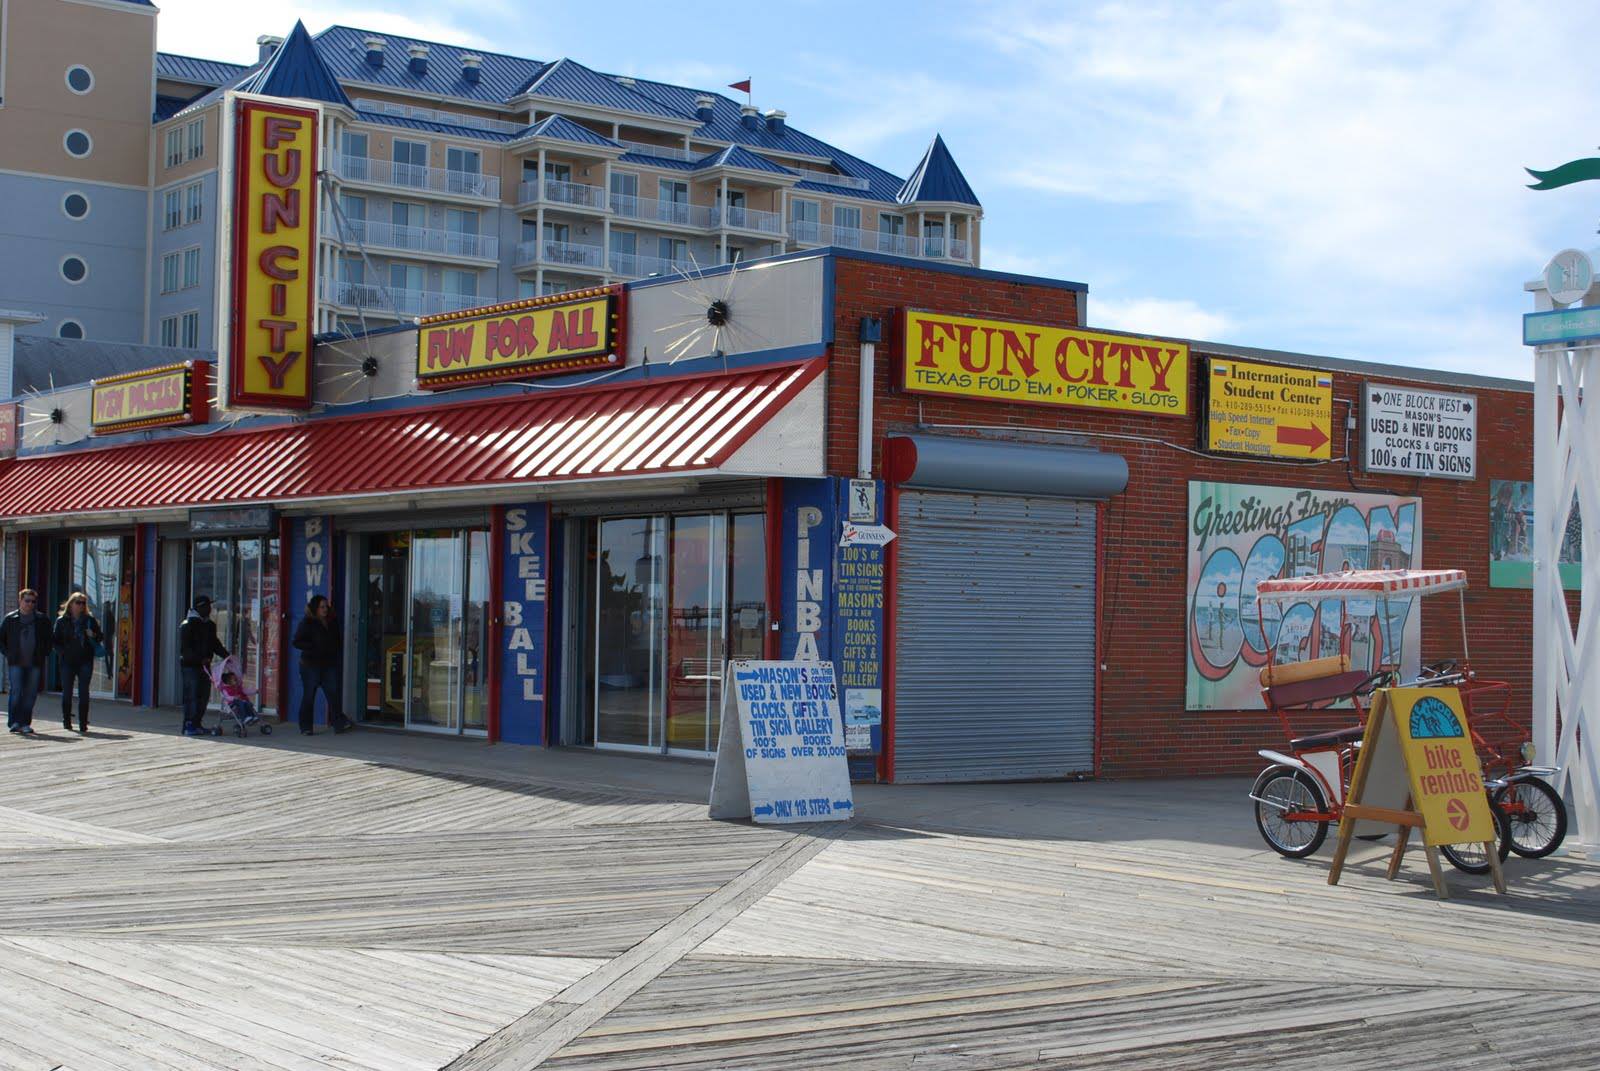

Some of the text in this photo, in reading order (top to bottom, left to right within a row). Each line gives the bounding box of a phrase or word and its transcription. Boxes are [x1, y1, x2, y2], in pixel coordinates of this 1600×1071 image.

[258, 116, 302, 390] FUN CITY
[427, 306, 598, 369] FUN FOR ALL
[915, 319, 1180, 392] FUN CITY
[1231, 364, 1317, 388] International
[914, 369, 1179, 408] TEXAS FOLD 'EM POKER SLOTS
[1223, 381, 1322, 405] Student Center
[1383, 392, 1461, 413] ONE BLOCK WEST
[1210, 410, 1275, 425] High Speed Internet
[1404, 410, 1441, 423] MASON'S
[1371, 418, 1472, 442] USED & NEW BOOKS
[1216, 438, 1271, 454] Student Housing
[1385, 437, 1458, 454] CLOCKS & GIFTS
[1400, 451, 1412, 468] of
[1415, 452, 1434, 470] TIN
[1438, 454, 1471, 474] SIGNS
[1193, 496, 1294, 552] Greetings
[304, 516, 324, 603] BOW
[843, 547, 879, 561] 100'S OF
[841, 563, 884, 577] TIN SIGNS
[503, 508, 546, 701] SKEE BALL
[838, 592, 884, 609] MASON'S
[847, 619, 875, 632] BOOKS
[845, 632, 877, 646] CLOCKS
[843, 646, 877, 659] GIFTS &
[842, 660, 878, 673] TIN SIGN
[759, 668, 808, 684] MASON'S
[841, 673, 878, 687] GALLERY
[740, 684, 766, 701] USED
[769, 684, 777, 701] &
[781, 684, 802, 701] NEW
[805, 684, 837, 700] BOOKS
[792, 701, 819, 718] GIFTS
[822, 701, 829, 717] &
[749, 719, 767, 737] TIN
[769, 719, 792, 736] SIGN
[794, 718, 834, 735] GALLERY
[753, 735, 832, 748] 100'S BOOKS
[746, 746, 846, 759] OF SIGNS OVER 20,000
[1423, 745, 1463, 770] bike
[1419, 769, 1480, 795] rentals
[774, 800, 793, 818] ONLY
[809, 798, 831, 816] STEPS
